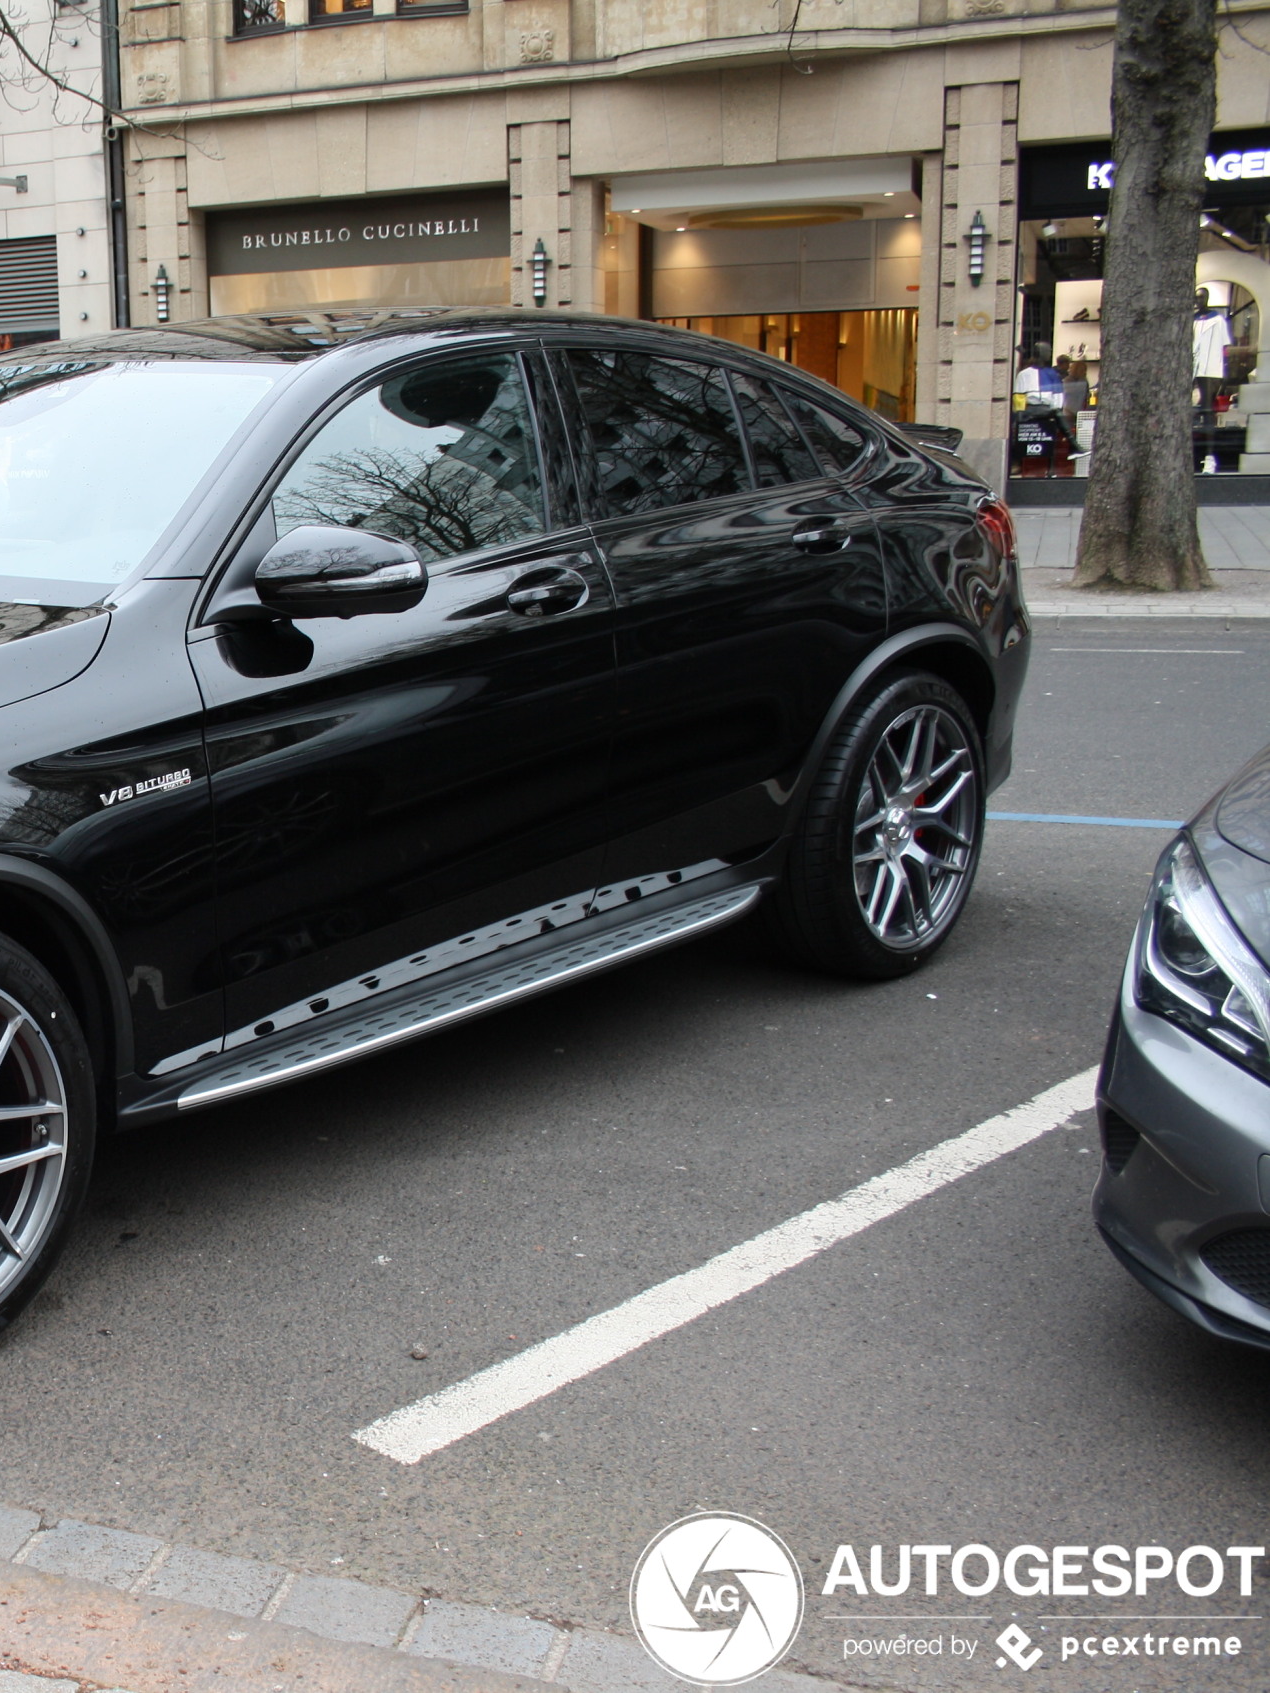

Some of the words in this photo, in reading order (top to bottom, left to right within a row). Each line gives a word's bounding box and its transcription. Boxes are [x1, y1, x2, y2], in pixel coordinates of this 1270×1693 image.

[242, 227, 351, 249] BRUNELLO
[362, 217, 479, 240] CUCINELLI
[99, 785, 133, 806] V8
[136, 768, 190, 791] BITURBO
